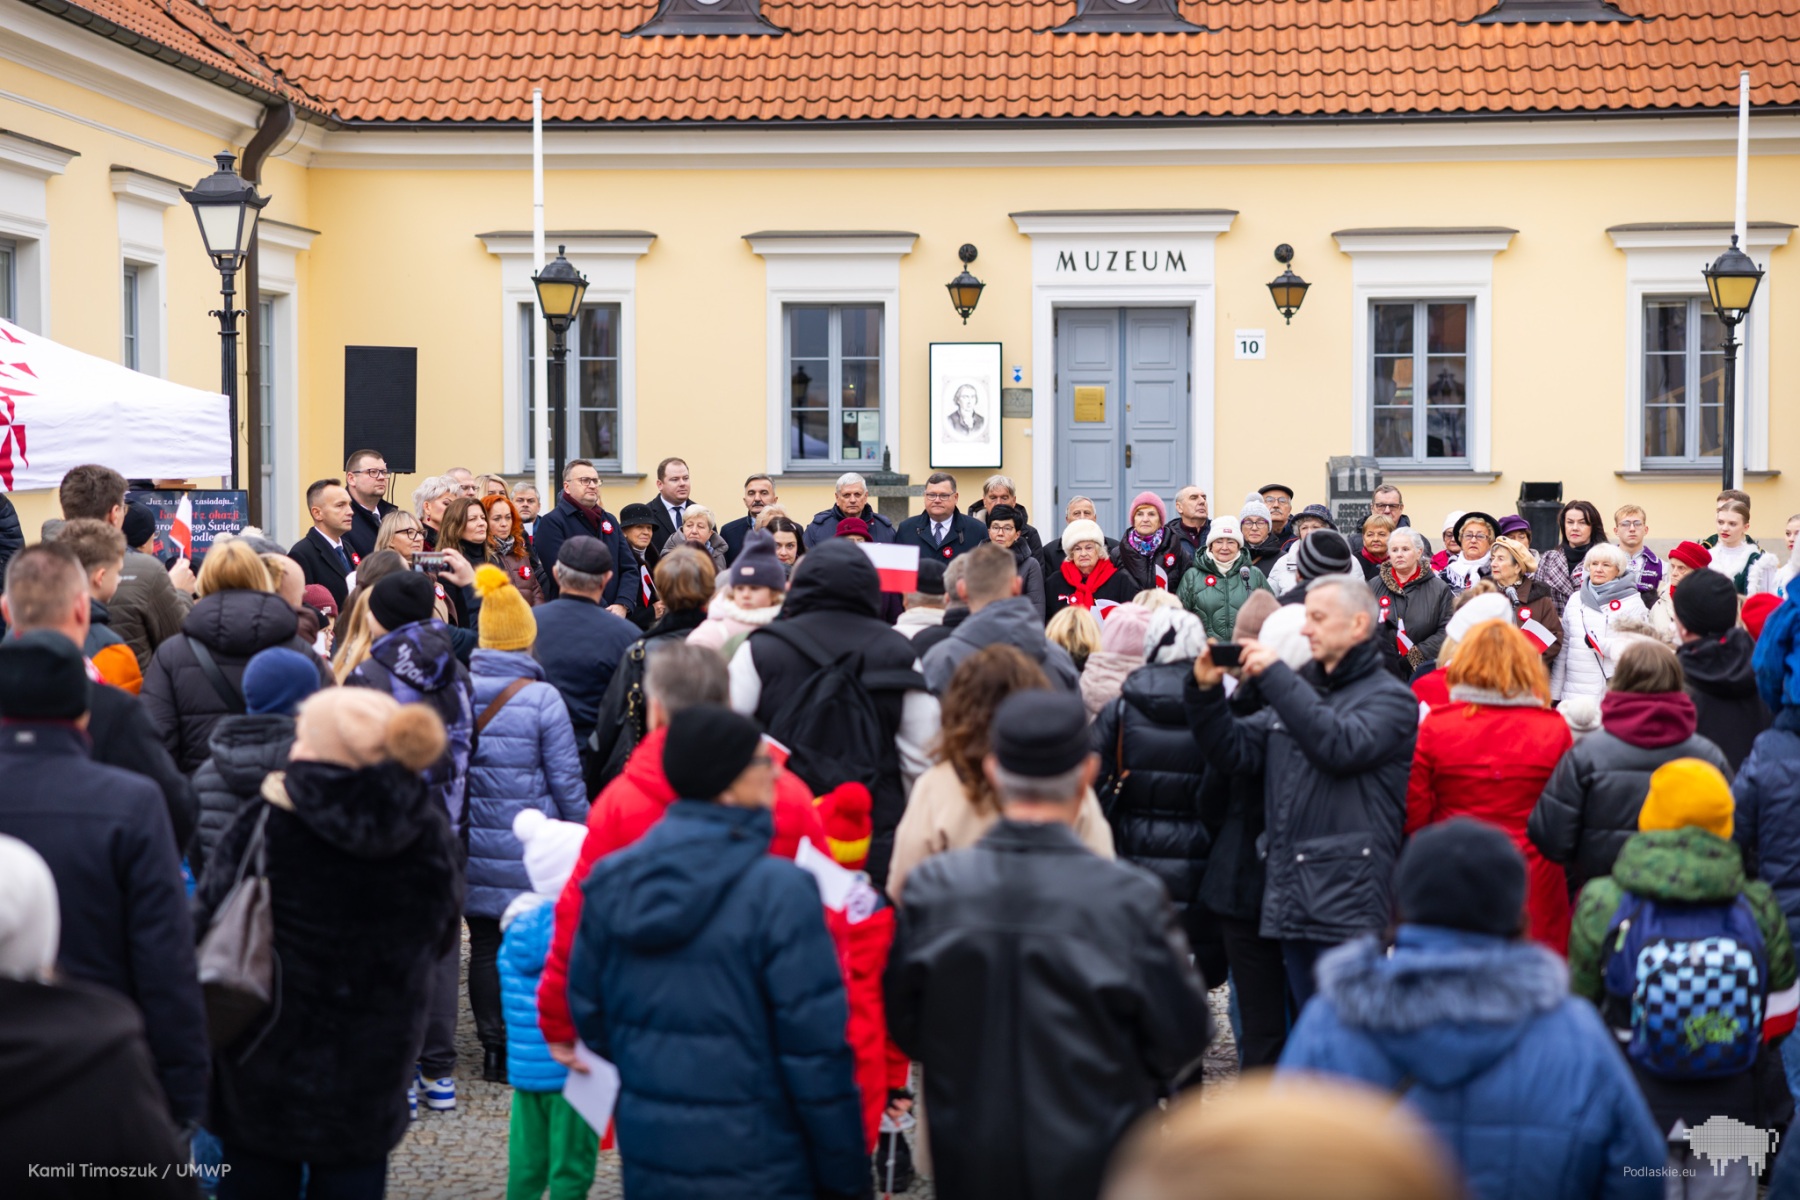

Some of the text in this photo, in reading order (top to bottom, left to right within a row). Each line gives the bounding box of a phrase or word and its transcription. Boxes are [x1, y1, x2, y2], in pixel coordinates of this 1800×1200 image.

[1056, 249, 1187, 272] MUZEUM
[1240, 340, 1259, 354] 10
[207, 518, 240, 533] Święta
